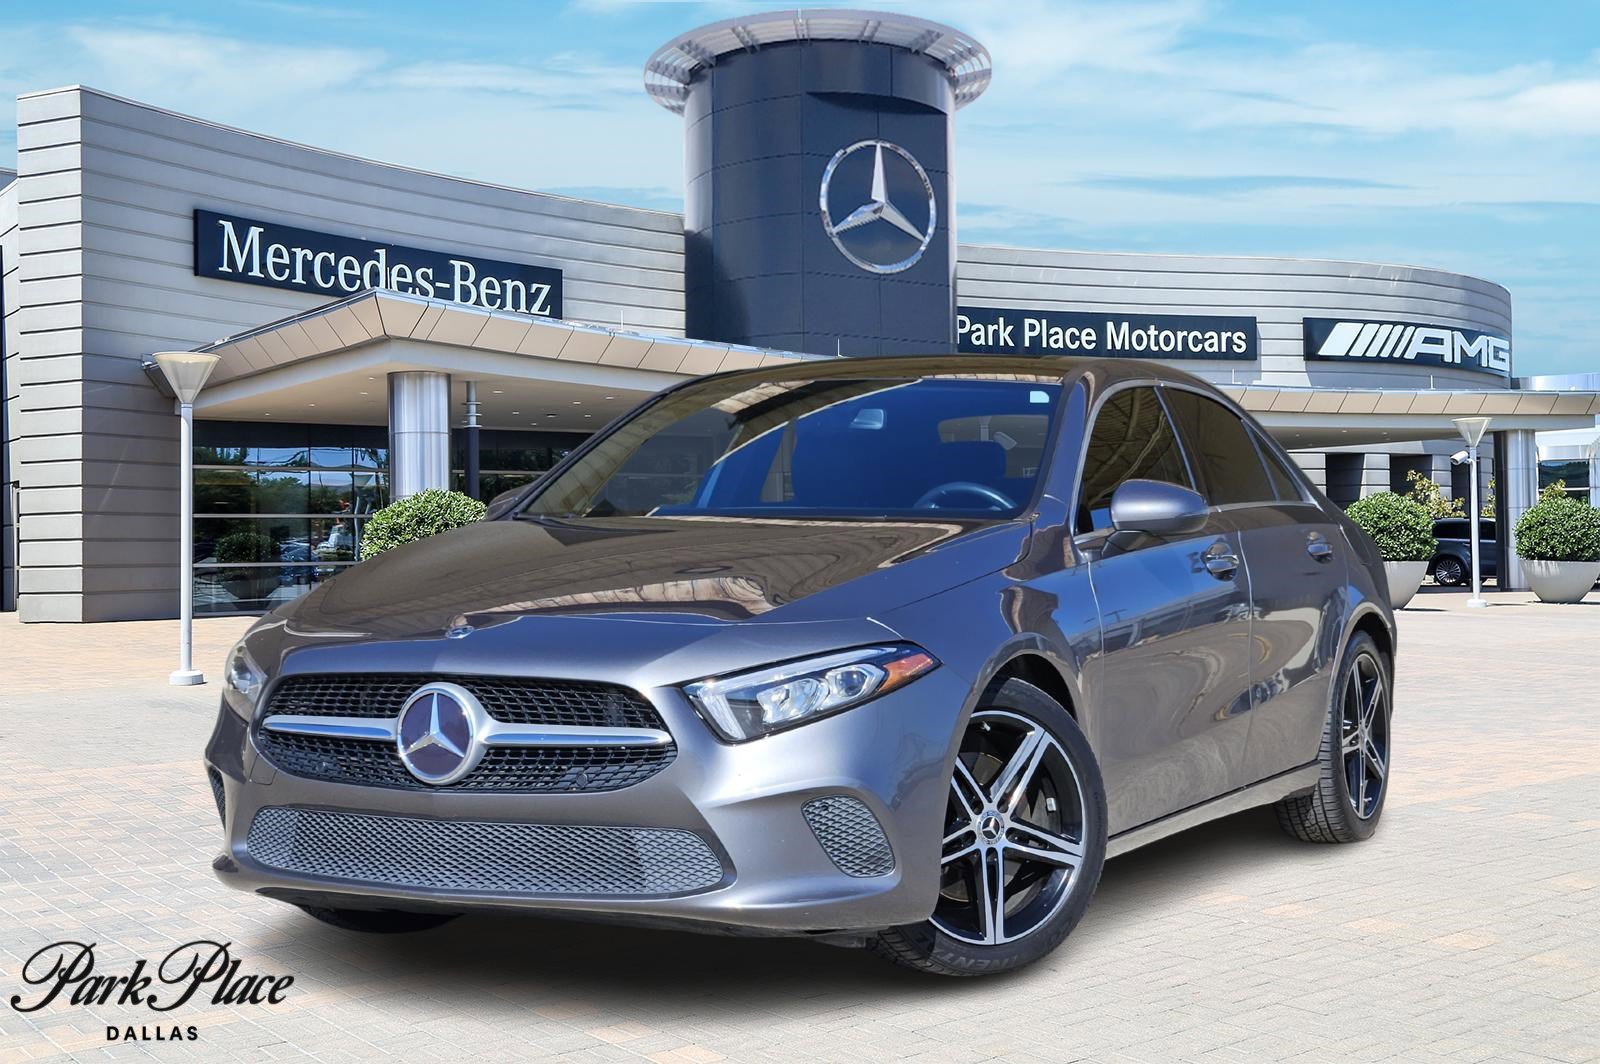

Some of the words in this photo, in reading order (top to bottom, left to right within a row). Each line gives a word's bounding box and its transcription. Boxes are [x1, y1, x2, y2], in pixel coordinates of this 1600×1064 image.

[218, 219, 552, 316] Mercedes-Benz
[957, 314, 1015, 347] Park
[1024, 318, 1097, 350] Place
[1106, 321, 1248, 353] Motorcars
[1403, 327, 1510, 372] AMG
